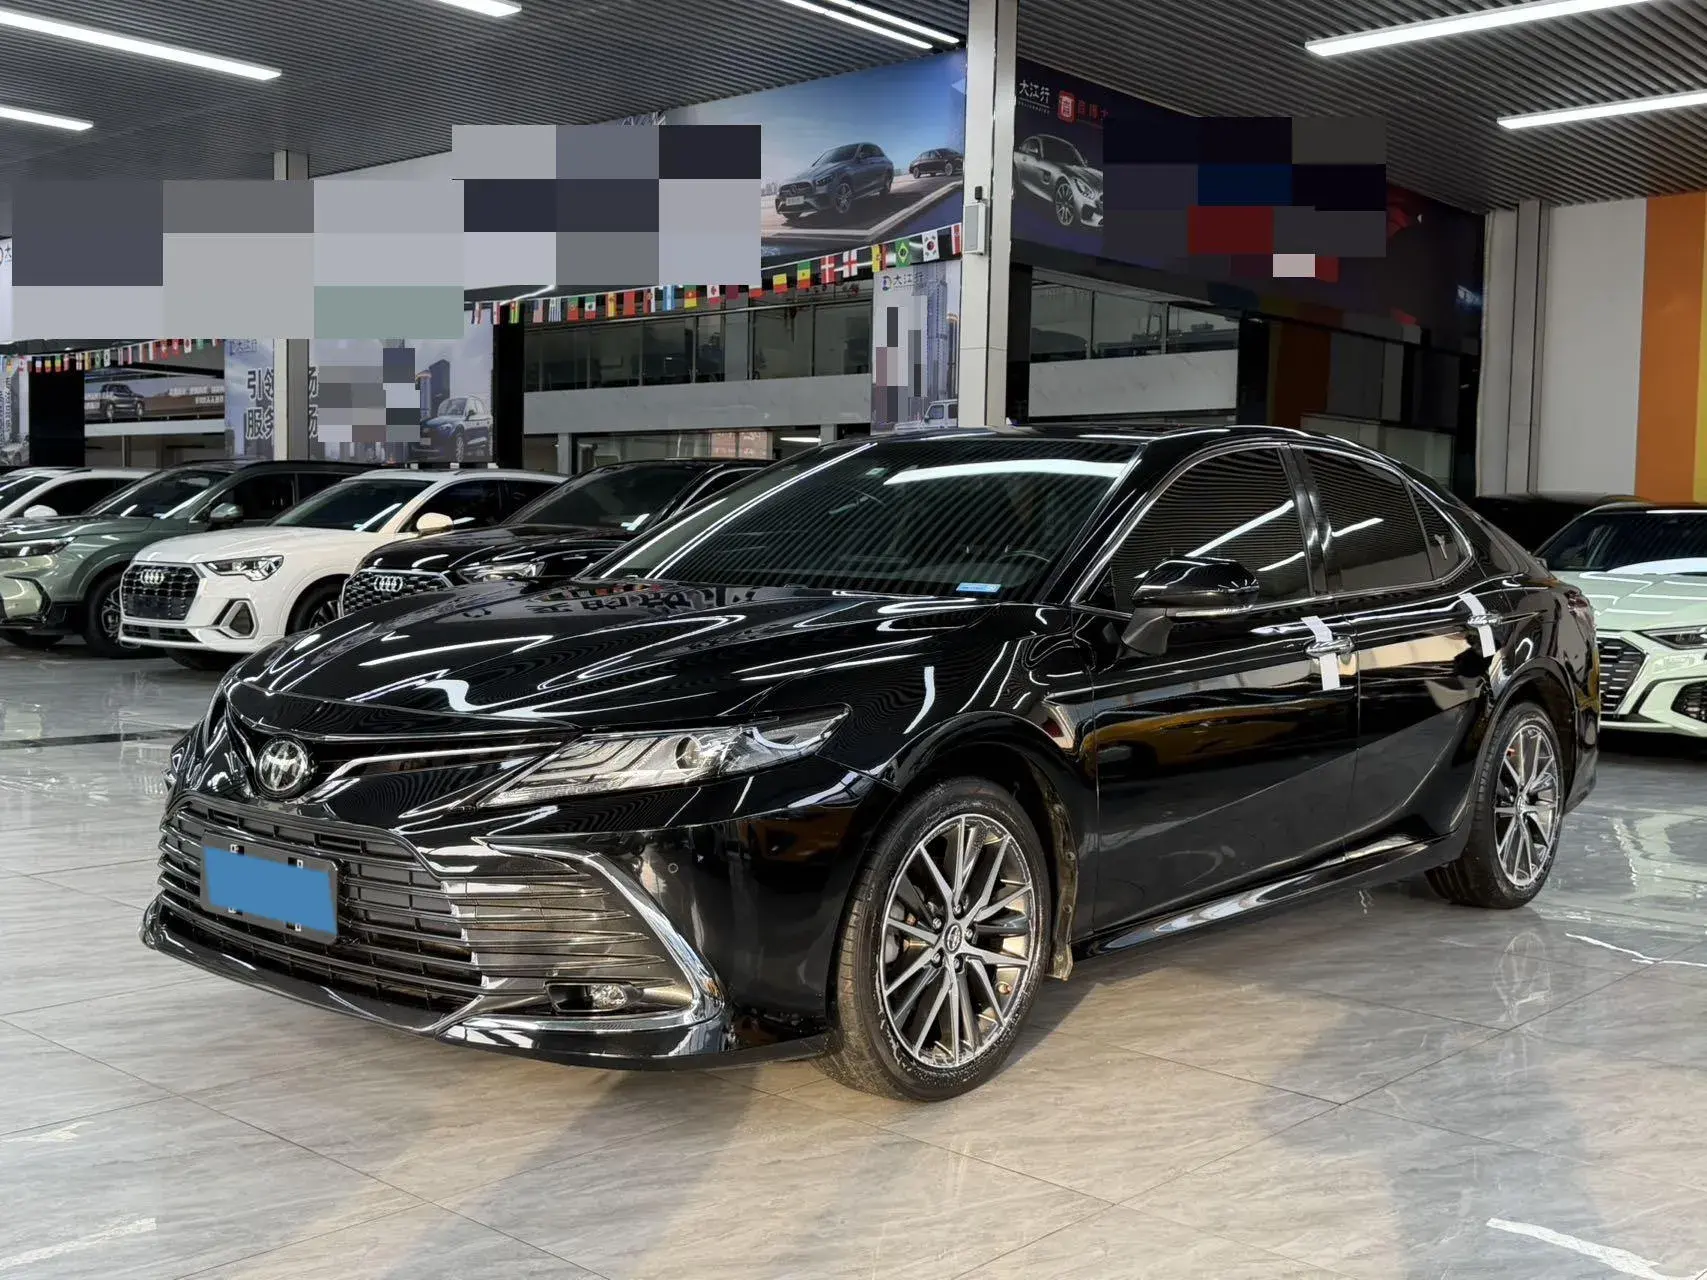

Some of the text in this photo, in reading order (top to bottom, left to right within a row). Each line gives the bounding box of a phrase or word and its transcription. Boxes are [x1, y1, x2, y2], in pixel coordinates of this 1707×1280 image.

[1019, 79, 1050, 104] 大江行
[893, 271, 924, 287] 大江行
